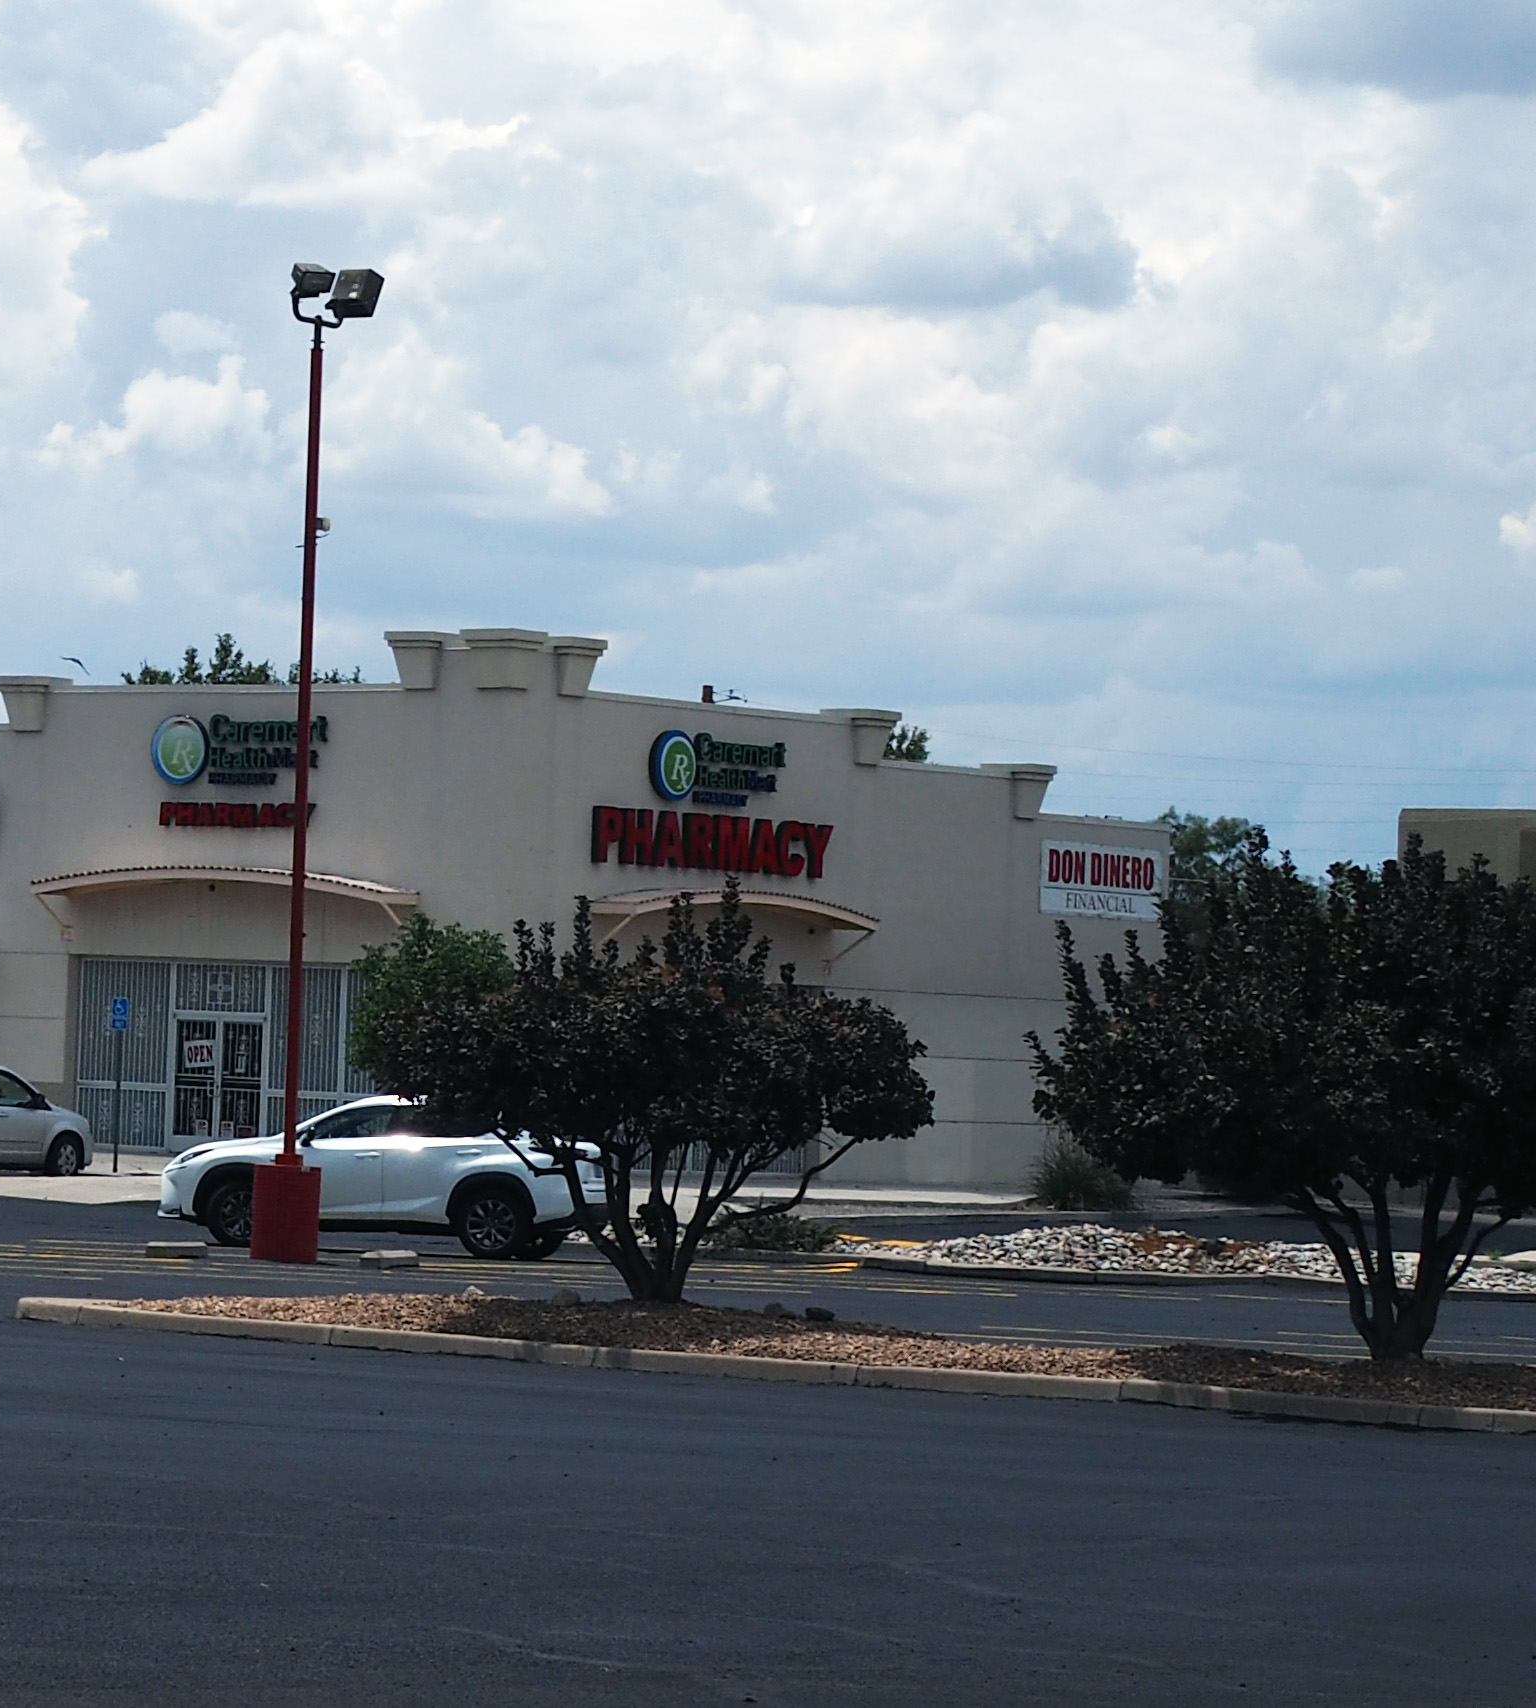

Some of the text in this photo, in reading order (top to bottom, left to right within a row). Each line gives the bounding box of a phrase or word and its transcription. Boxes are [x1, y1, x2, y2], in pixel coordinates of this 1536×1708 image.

[209, 747, 269, 769] Health
[694, 732, 787, 768] Caremart
[697, 764, 747, 791] Health
[159, 801, 317, 829] PHARMAC
[591, 804, 834, 879] PHARMACY
[1048, 848, 1155, 891] DON DINERO
[1065, 892, 1137, 914] FINANCIAL
[187, 1045, 213, 1064] OPEN
